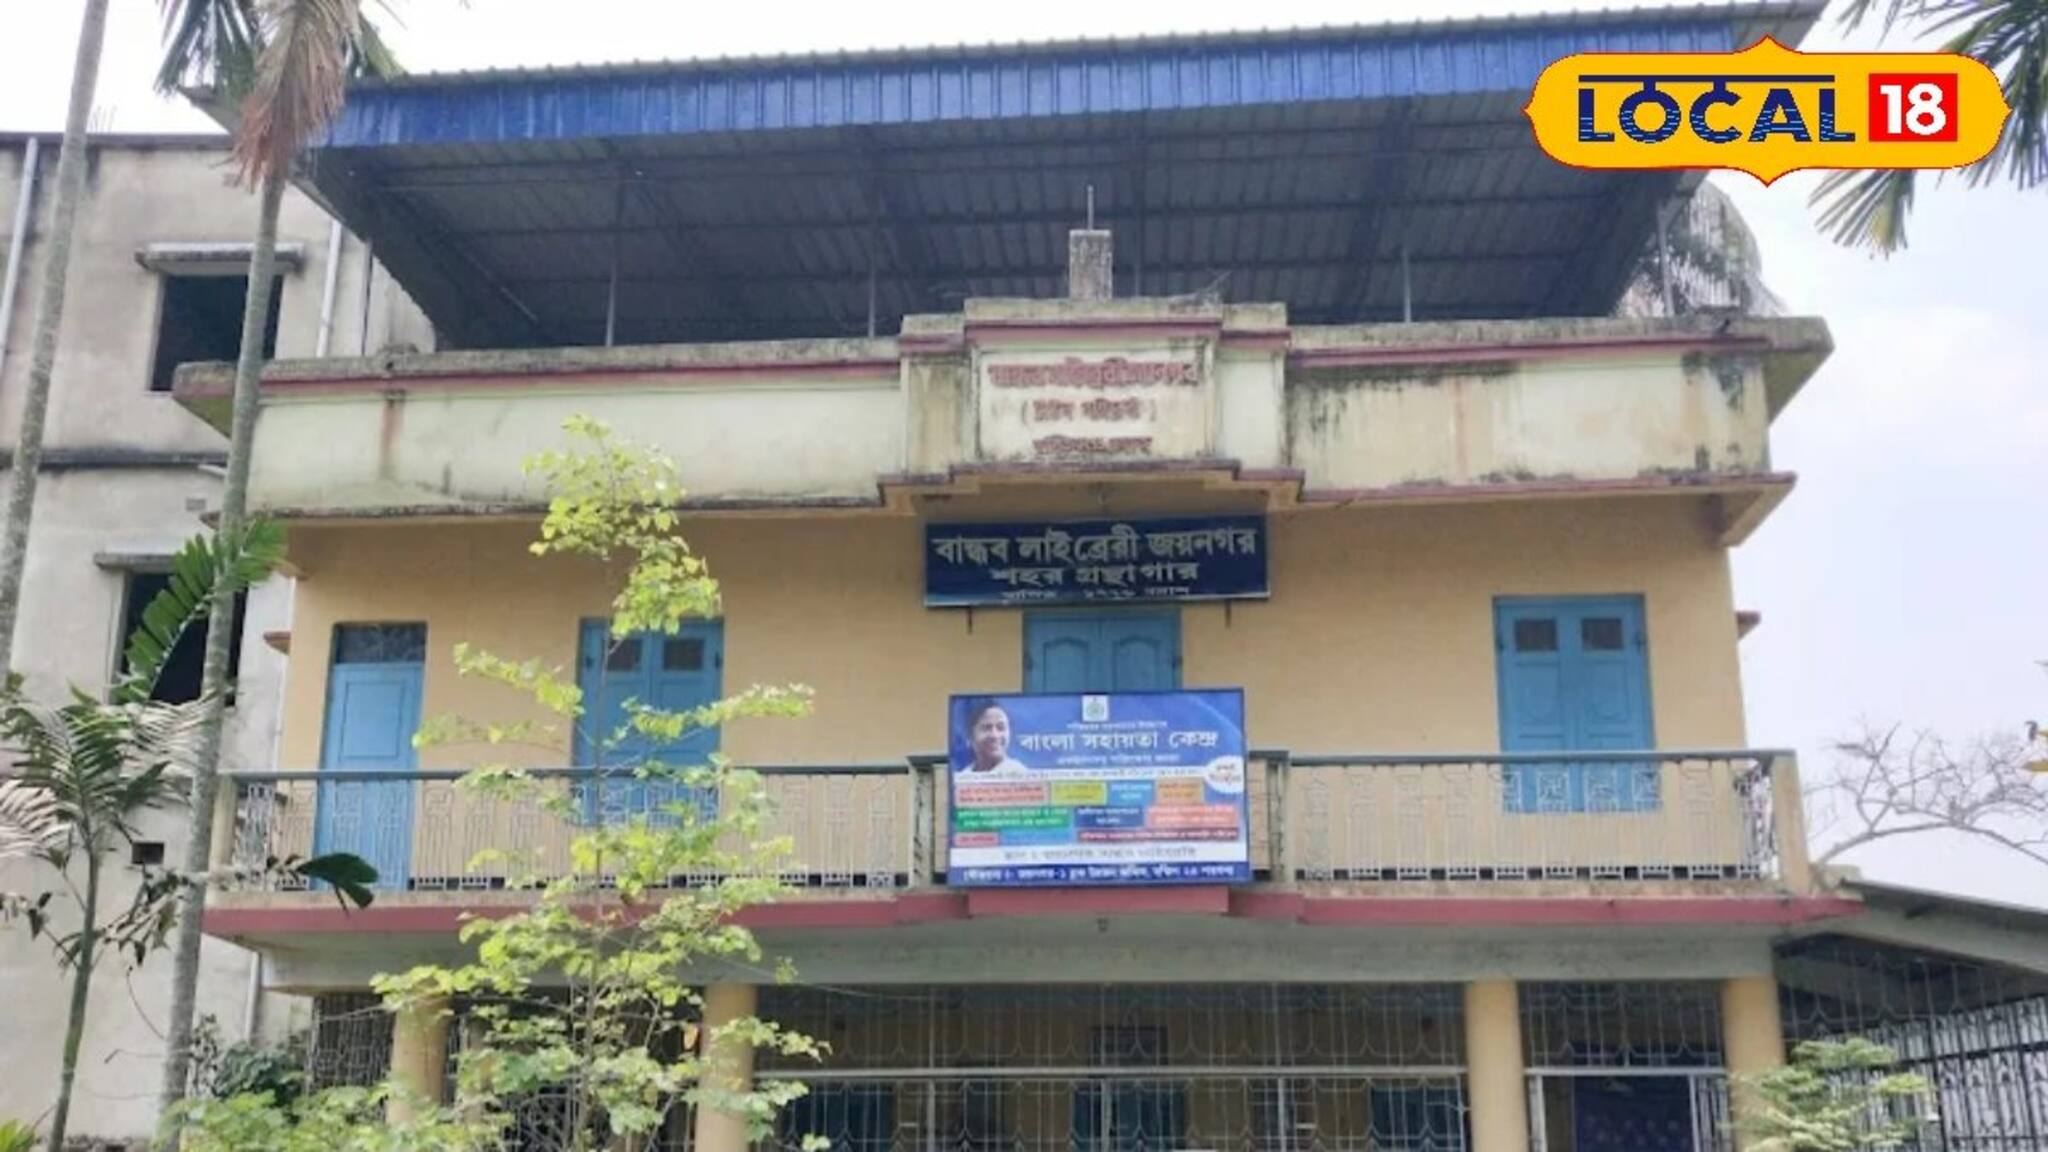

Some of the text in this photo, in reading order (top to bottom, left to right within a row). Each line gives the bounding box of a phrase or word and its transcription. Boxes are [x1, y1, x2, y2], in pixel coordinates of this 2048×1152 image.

[932, 524, 1257, 566] বান্ধব লাইব্রেরী জয়নগর
[988, 566, 1064, 588] শহর
[1018, 729, 1219, 751] বাংলা সহায়তা কেন্দ্র
